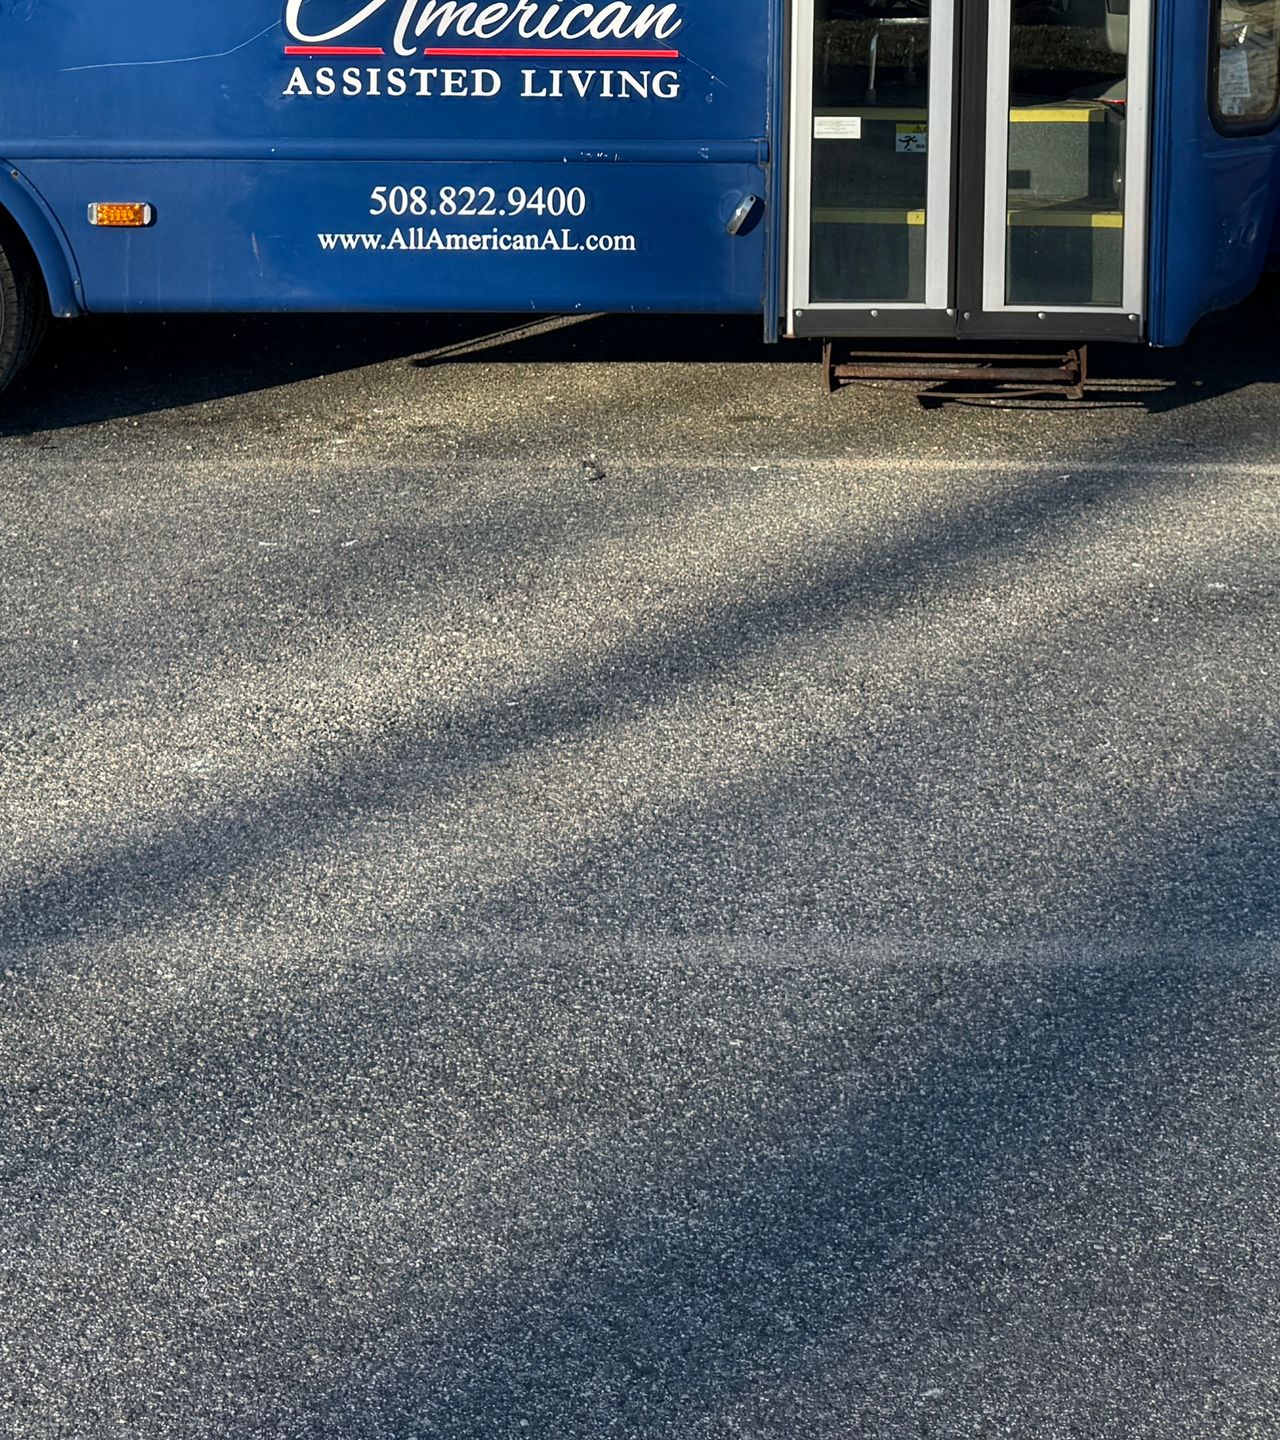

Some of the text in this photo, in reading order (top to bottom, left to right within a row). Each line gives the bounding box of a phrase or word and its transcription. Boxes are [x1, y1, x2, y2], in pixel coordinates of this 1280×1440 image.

[282, 66, 680, 99] ASSISTED LIVING
[368, 185, 586, 216] 508.822.9400
[317, 227, 637, 252] www.AllAmericanAL.com
